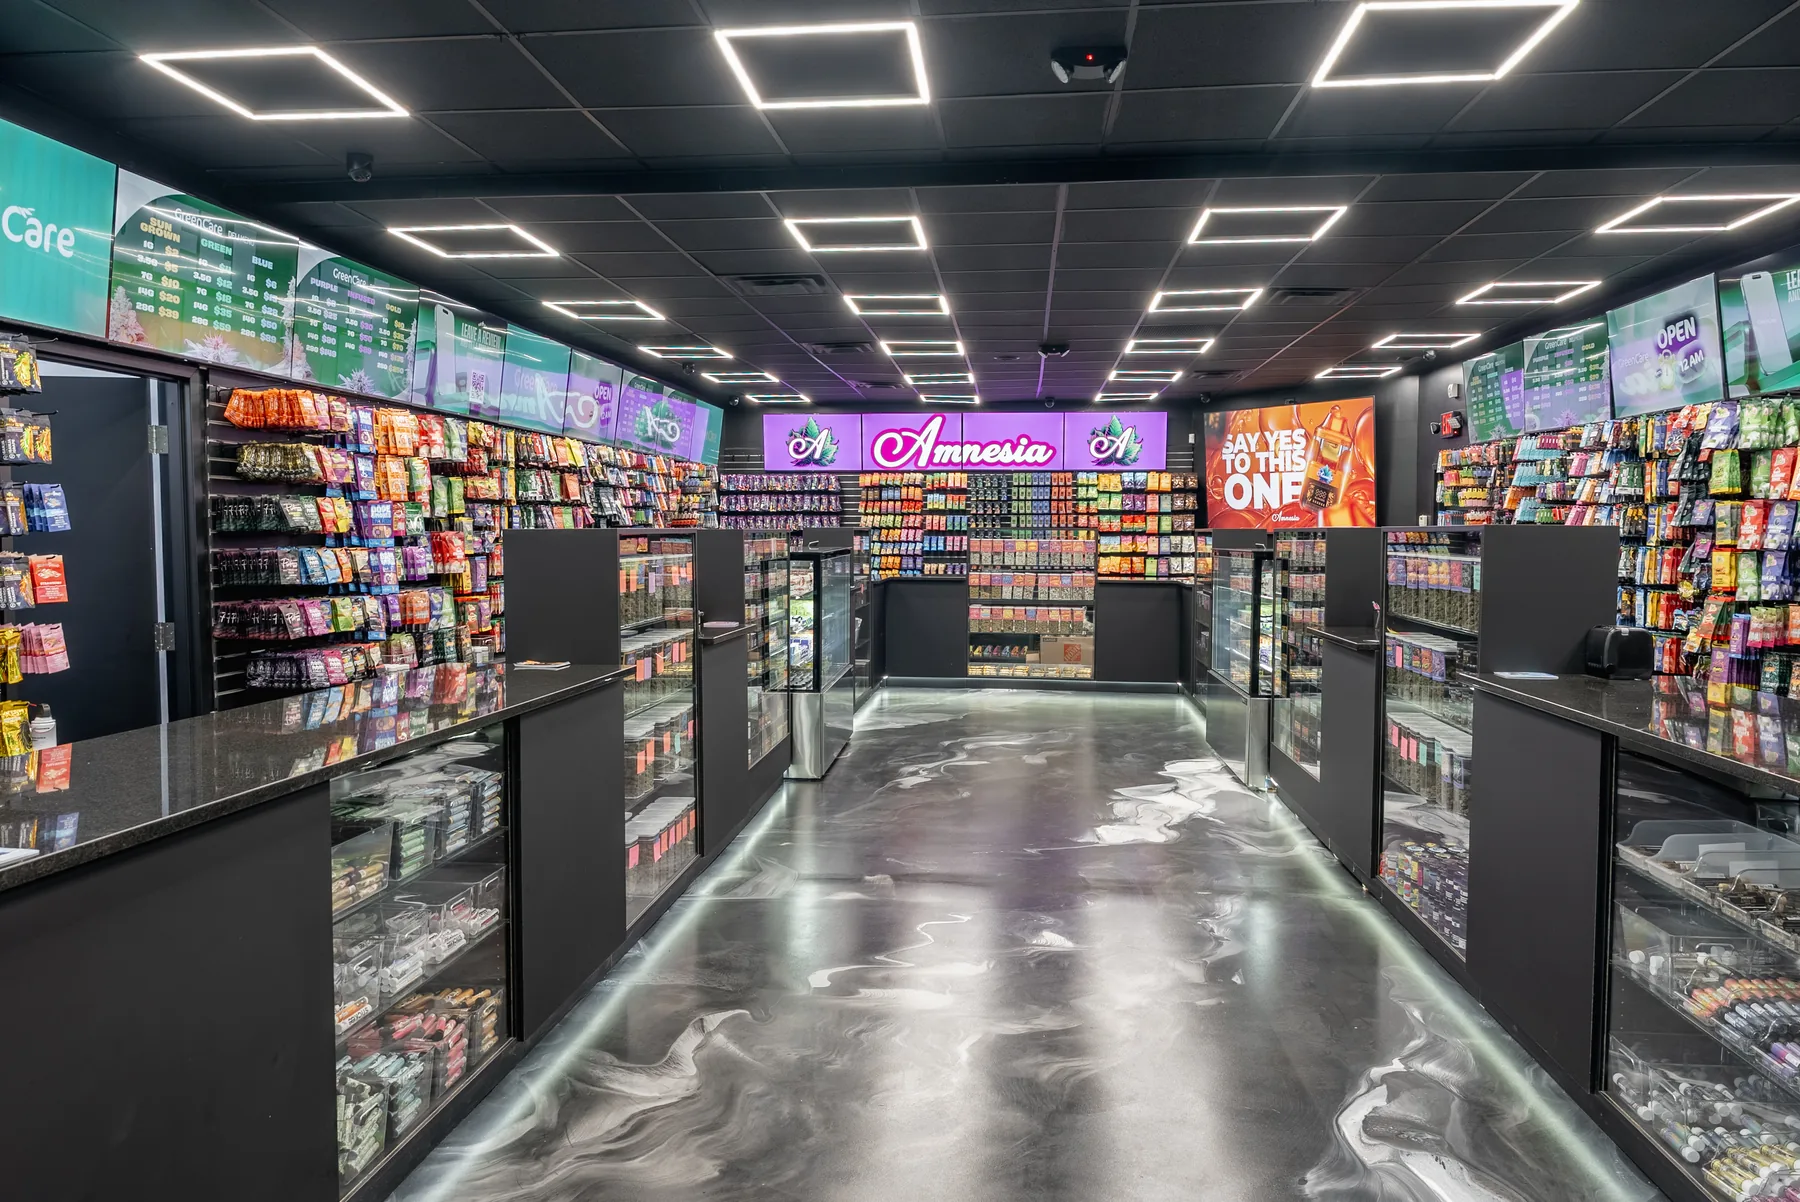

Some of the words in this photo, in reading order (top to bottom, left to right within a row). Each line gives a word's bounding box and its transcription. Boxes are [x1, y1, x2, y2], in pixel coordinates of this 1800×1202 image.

[150, 217, 172, 231] SUN
[174, 208, 223, 236] GreenCare
[2, 205, 75, 258] Care
[140, 222, 181, 243] GROWN
[200, 238, 232, 256] GREEN
[252, 255, 273, 270] BLUE
[141, 271, 153, 280] 7G
[161, 275, 180, 289] $10
[216, 277, 233, 290] $12
[310, 277, 339, 293] PURPLE
[333, 268, 367, 286] GreenCare
[1786, 269, 1800, 290] LE
[138, 287, 154, 297] 14G
[159, 290, 180, 305] $20
[347, 290, 376, 306] INFUSED
[213, 305, 233, 319] $35
[385, 303, 402, 314] GOLD
[461, 322, 478, 341] LEAVE
[482, 330, 502, 349] REVIEW
[1657, 316, 1697, 349] OPEN
[1544, 339, 1567, 350] GreenCare
[1680, 358, 1690, 372] 12
[1689, 349, 1704, 368] AM
[594, 385, 612, 401] OPEN
[788, 428, 830, 460] A
[873, 415, 1054, 468] Amnesia
[1089, 427, 1134, 459] A
[1222, 432, 1260, 454] SAY
[1264, 428, 1307, 451] YES
[1222, 452, 1251, 474] TO
[1255, 449, 1307, 472] THIS
[1224, 472, 1305, 510] ONE
[1271, 511, 1300, 522] Amnesia
